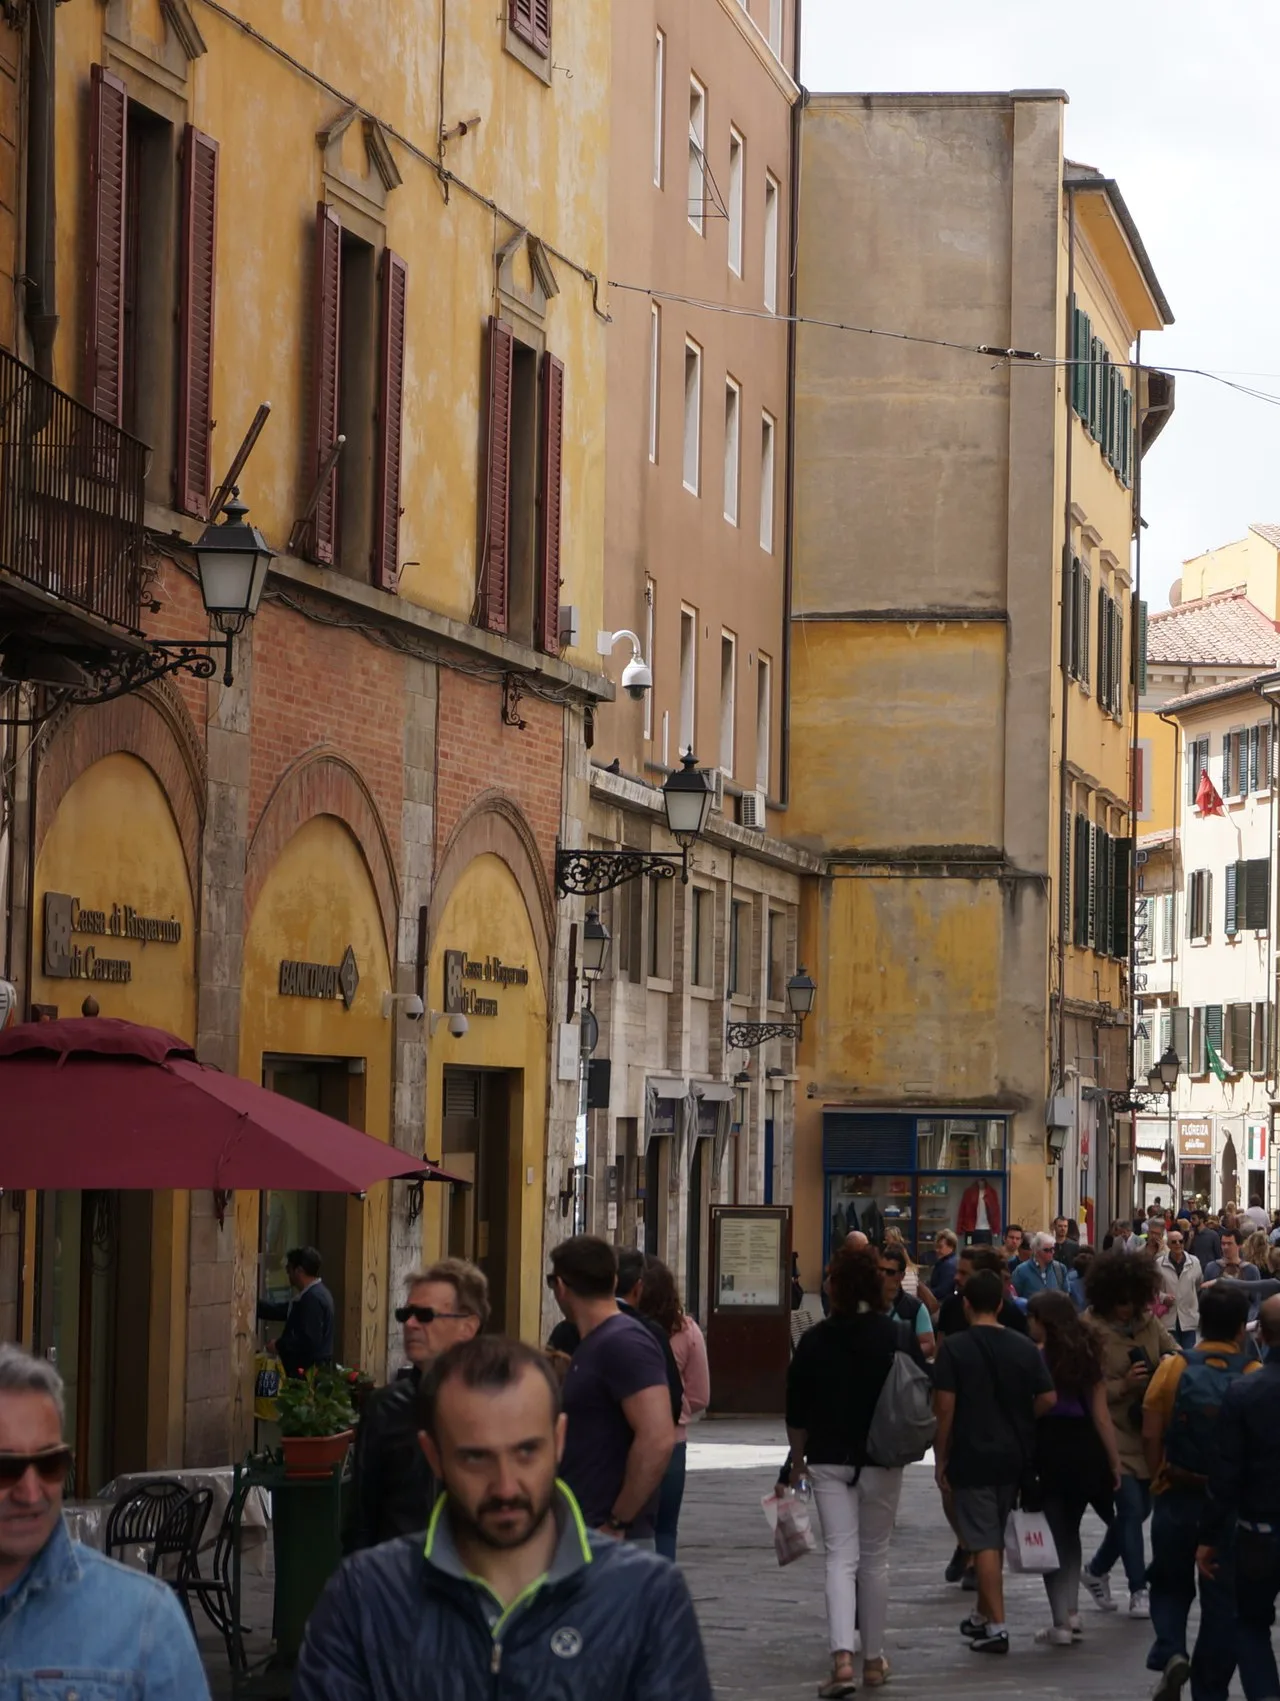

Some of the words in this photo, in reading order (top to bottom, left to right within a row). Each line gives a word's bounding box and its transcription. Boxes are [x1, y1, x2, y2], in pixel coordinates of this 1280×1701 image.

[70, 897, 105, 933] Cassa
[110, 902, 122, 936] di
[124, 904, 182, 948] Risparmio
[1133, 850, 1150, 1040] PIZZERIA
[70, 944, 82, 978] di
[85, 946, 132, 983] Carrara
[280, 960, 342, 1000] BANCOMAT
